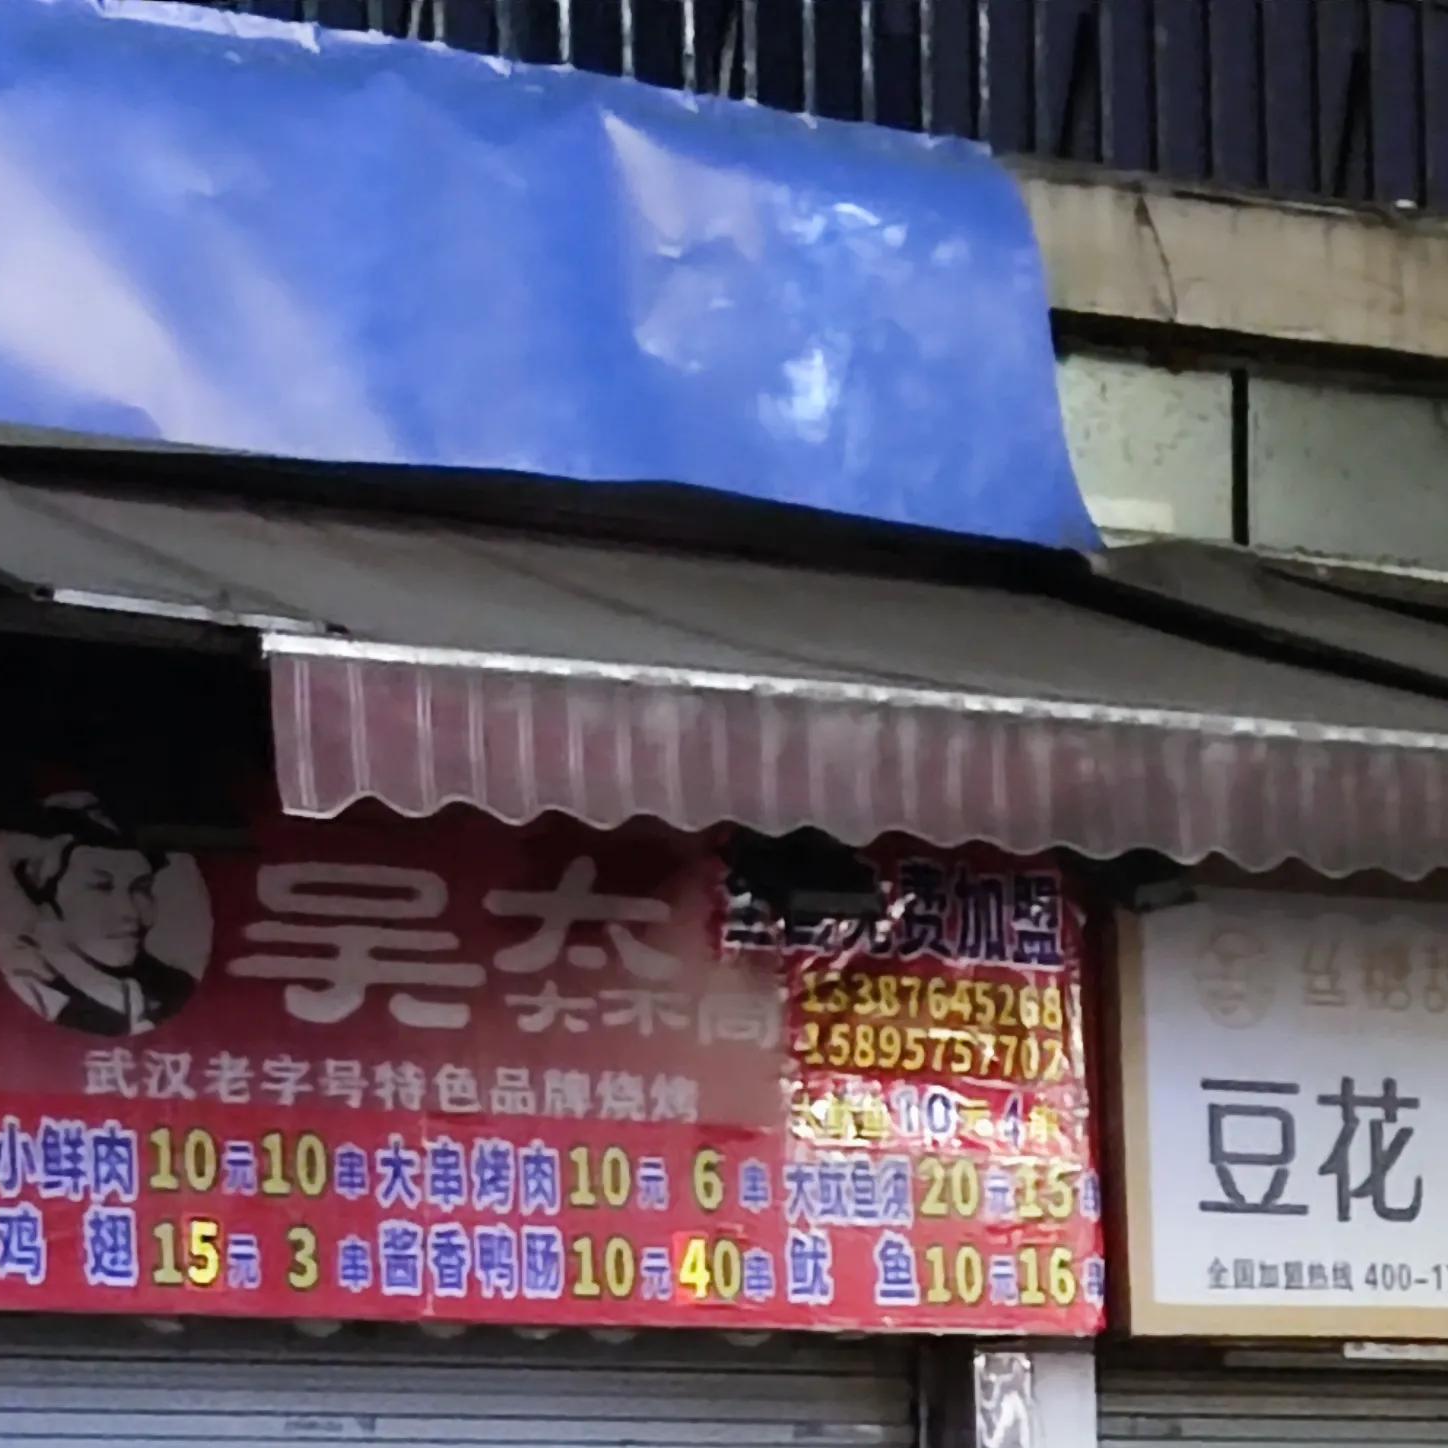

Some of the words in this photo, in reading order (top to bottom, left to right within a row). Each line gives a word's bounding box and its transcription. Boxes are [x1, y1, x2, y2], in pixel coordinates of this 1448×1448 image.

[82, 1047, 699, 1124] 武汉老字号特色品牌烧烤
[1199, 1075, 1423, 1222] 豆花
